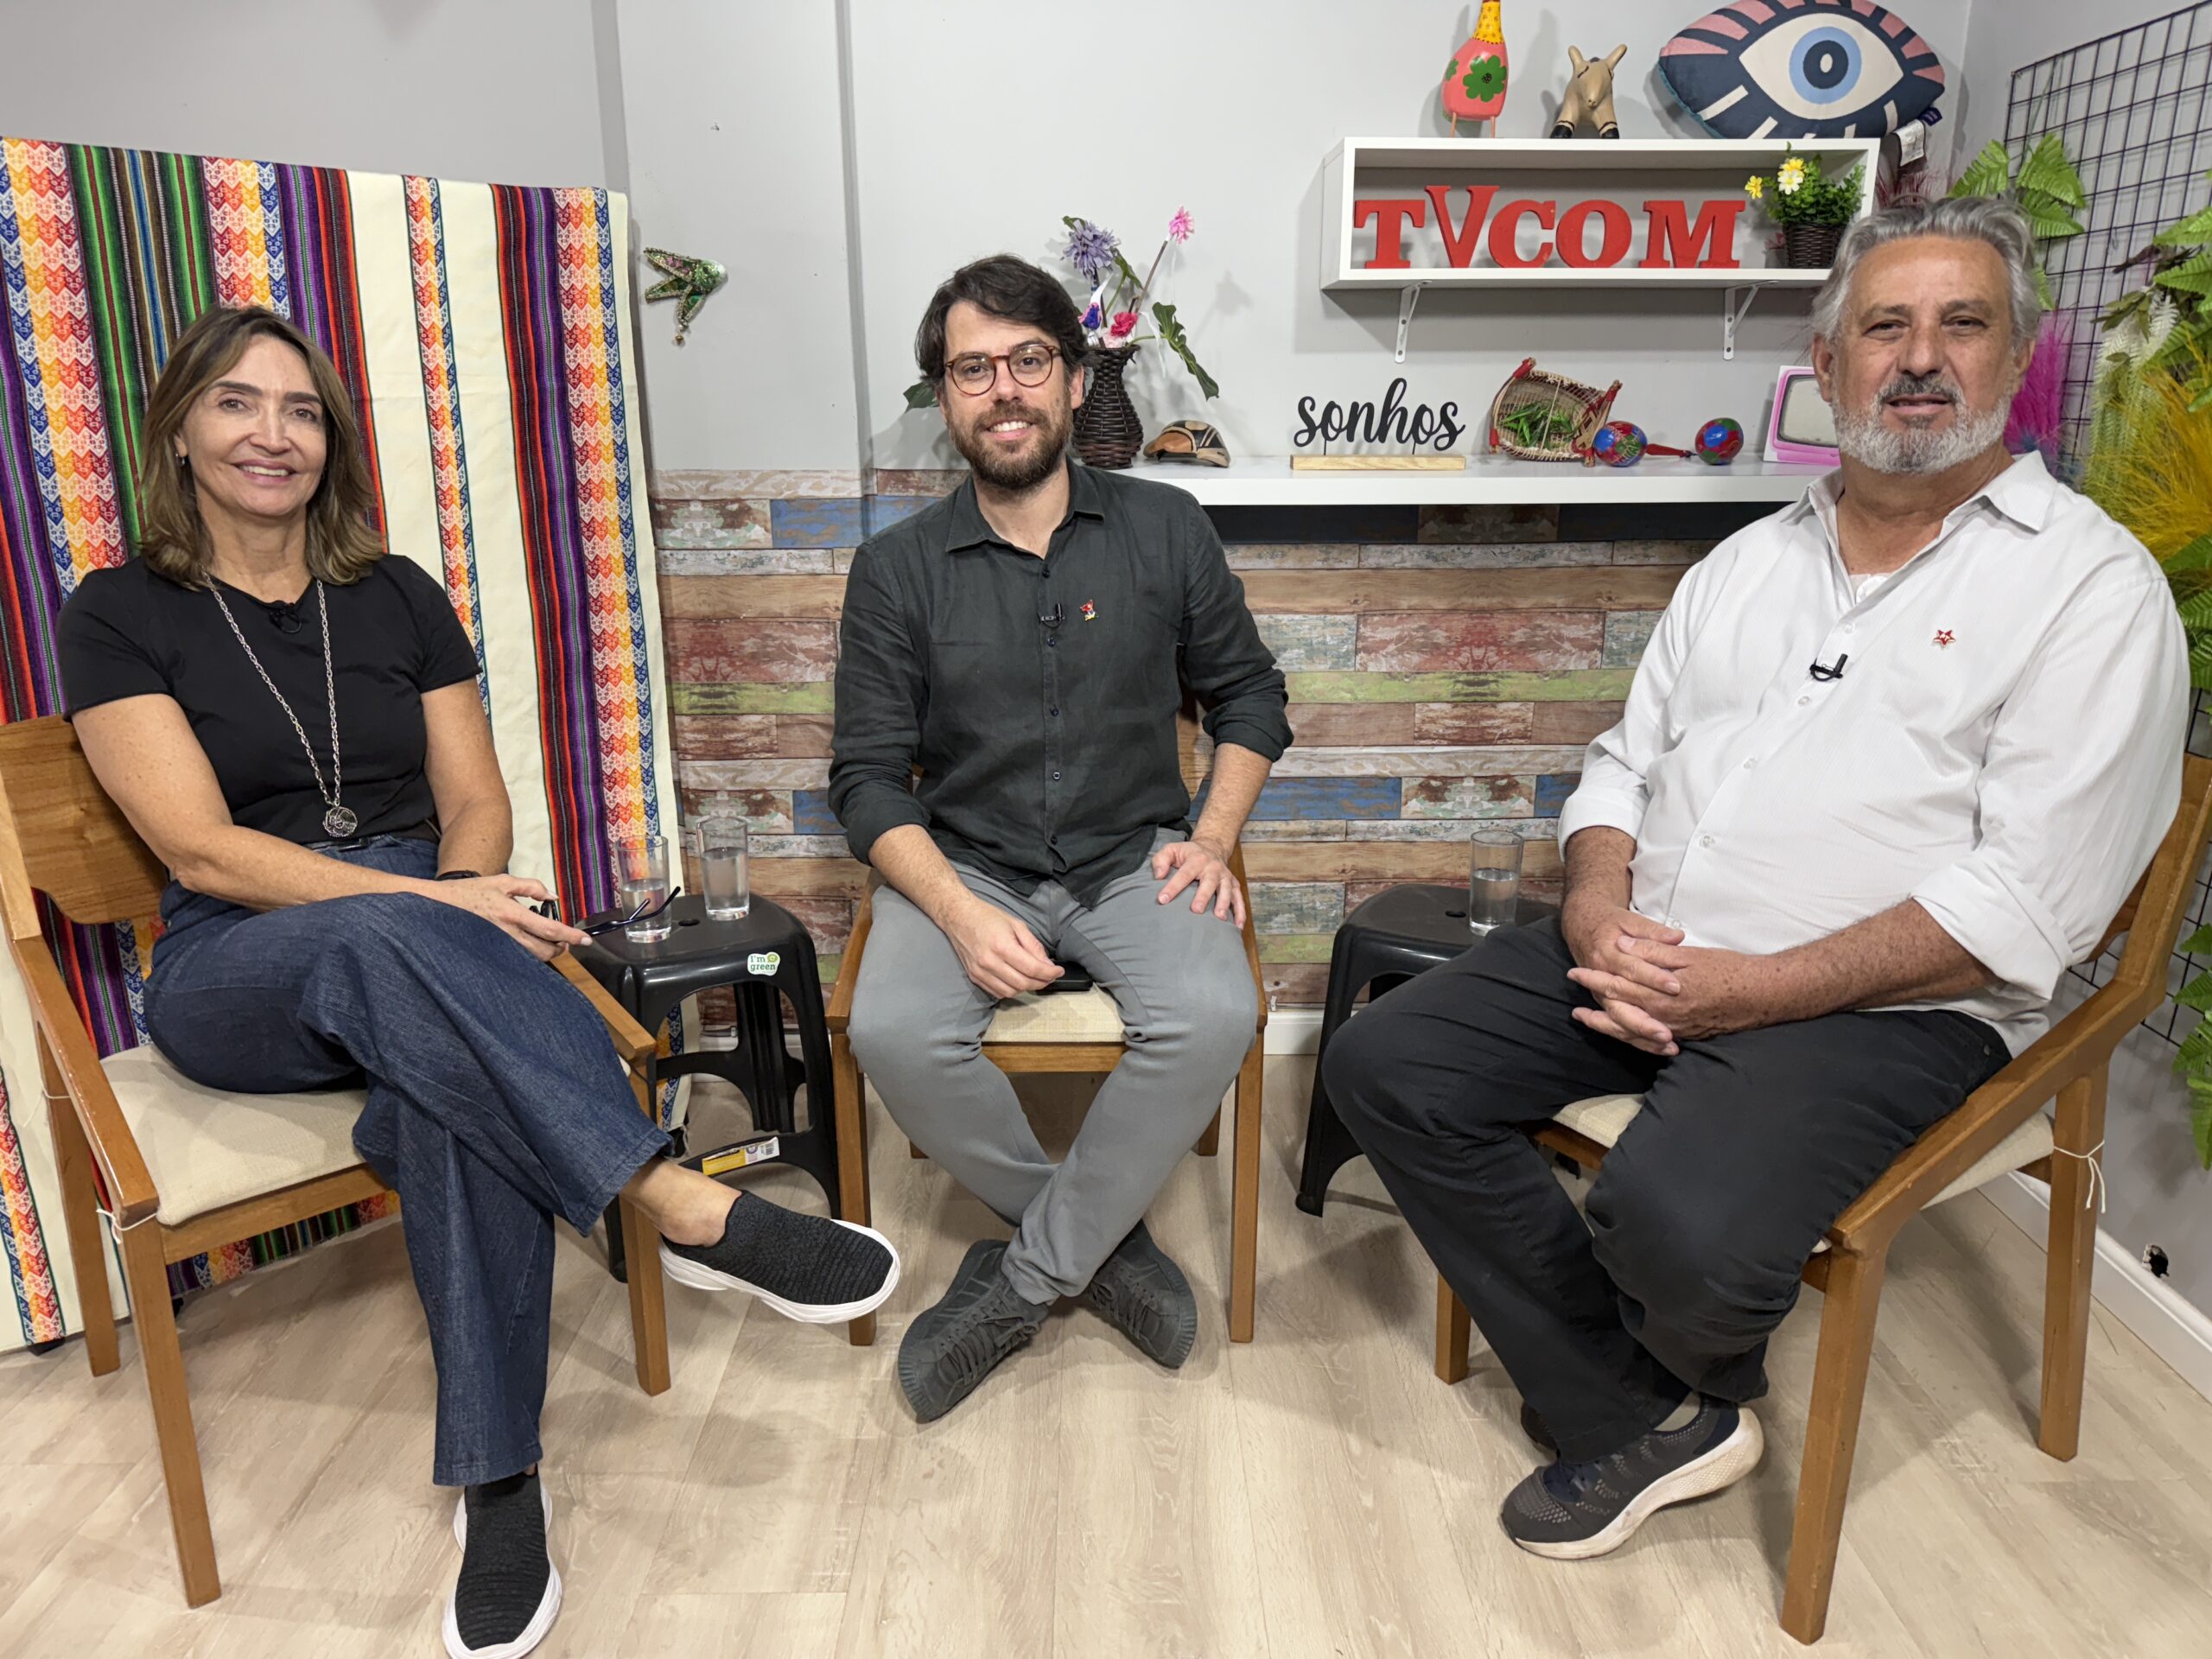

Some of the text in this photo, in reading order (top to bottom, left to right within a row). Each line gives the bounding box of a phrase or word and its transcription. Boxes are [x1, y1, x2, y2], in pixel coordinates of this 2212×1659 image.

[1353, 185, 1746, 269] TVCOM
[1294, 378, 1466, 451] sonhos
[750, 963, 776, 972] green
